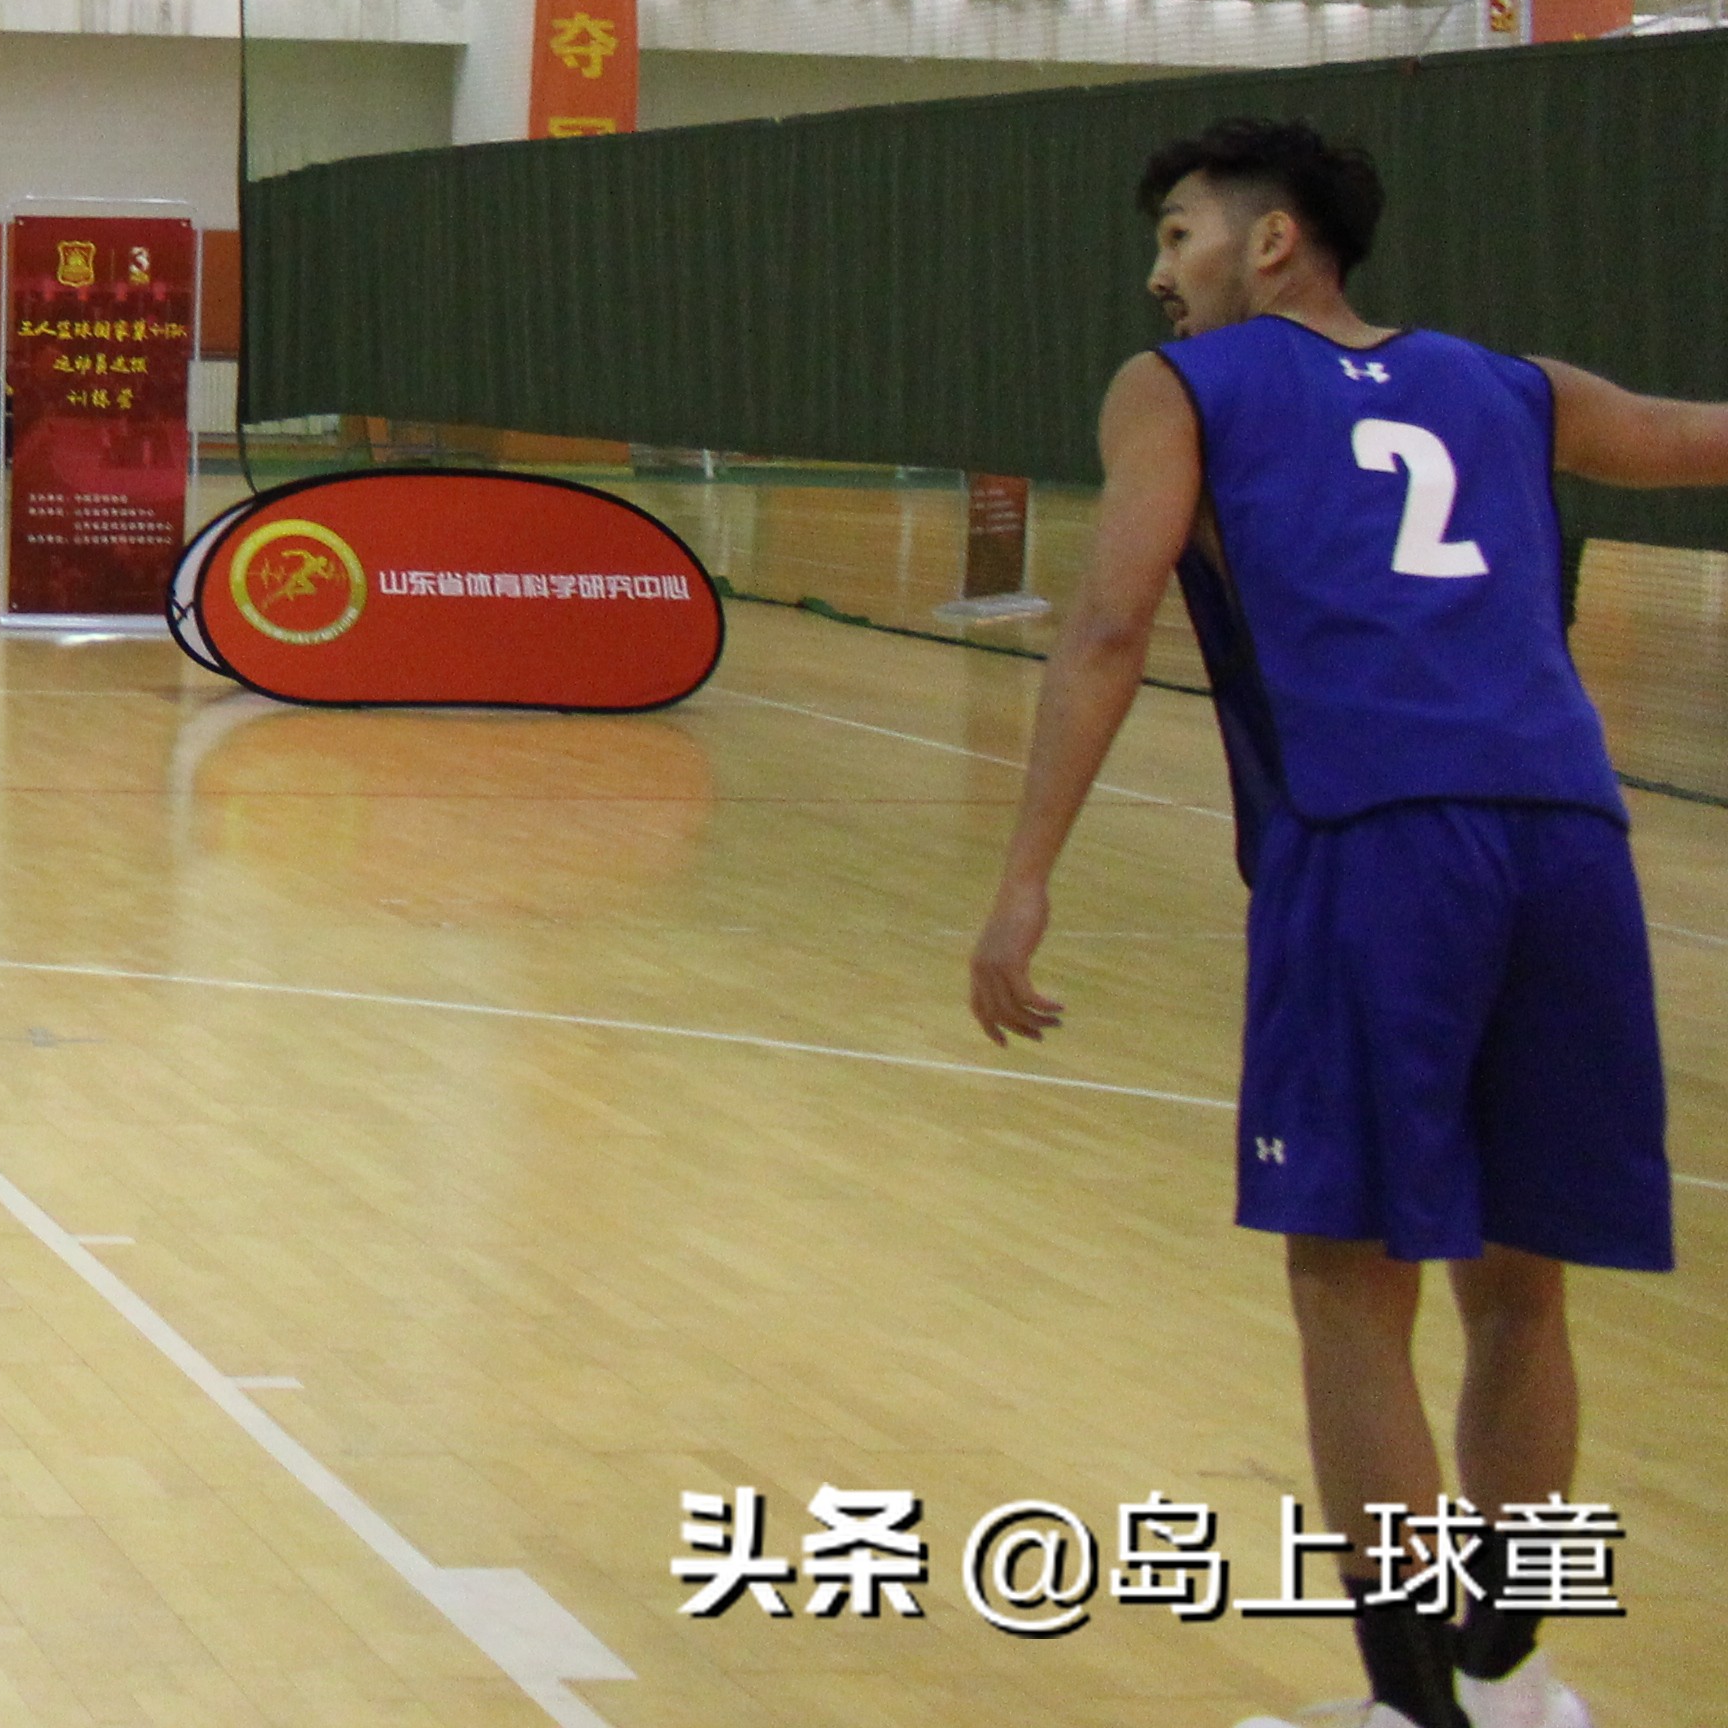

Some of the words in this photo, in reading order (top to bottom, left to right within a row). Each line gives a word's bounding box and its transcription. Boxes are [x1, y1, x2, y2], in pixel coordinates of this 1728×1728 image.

[1351, 417, 1490, 578] 2
[378, 570, 691, 602] 山东省体育科学研究中心
